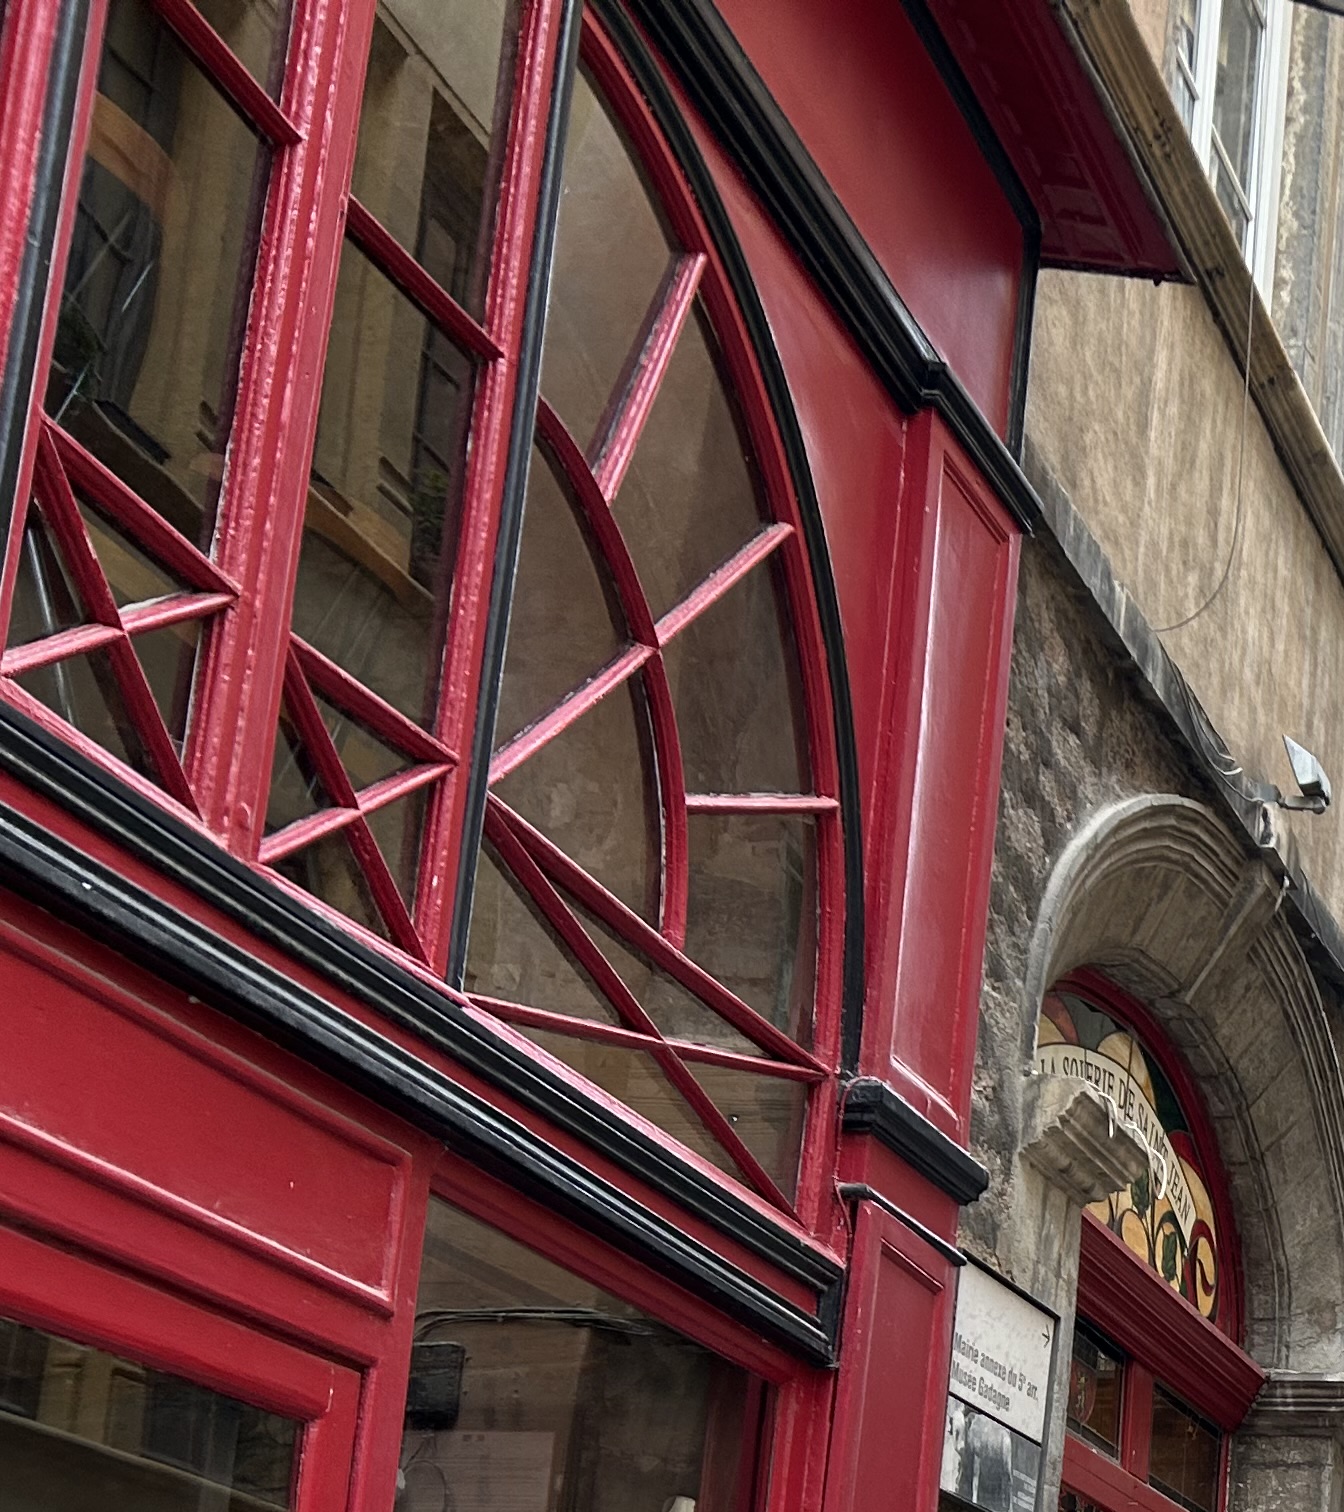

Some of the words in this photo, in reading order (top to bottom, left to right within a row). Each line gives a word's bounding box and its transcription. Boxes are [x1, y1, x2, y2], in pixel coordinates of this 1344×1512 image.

[1118, 1078, 1136, 1121] DE
[1167, 1161, 1191, 1224] JEAN
[951, 1360, 977, 1393] Musée
[978, 1376, 1010, 1412] Gadagne
[953, 1331, 979, 1365] Mairie
[979, 1352, 1007, 1382] annexe
[1007, 1367, 1018, 1388] du
[1026, 1381, 1040, 1402] arr.
